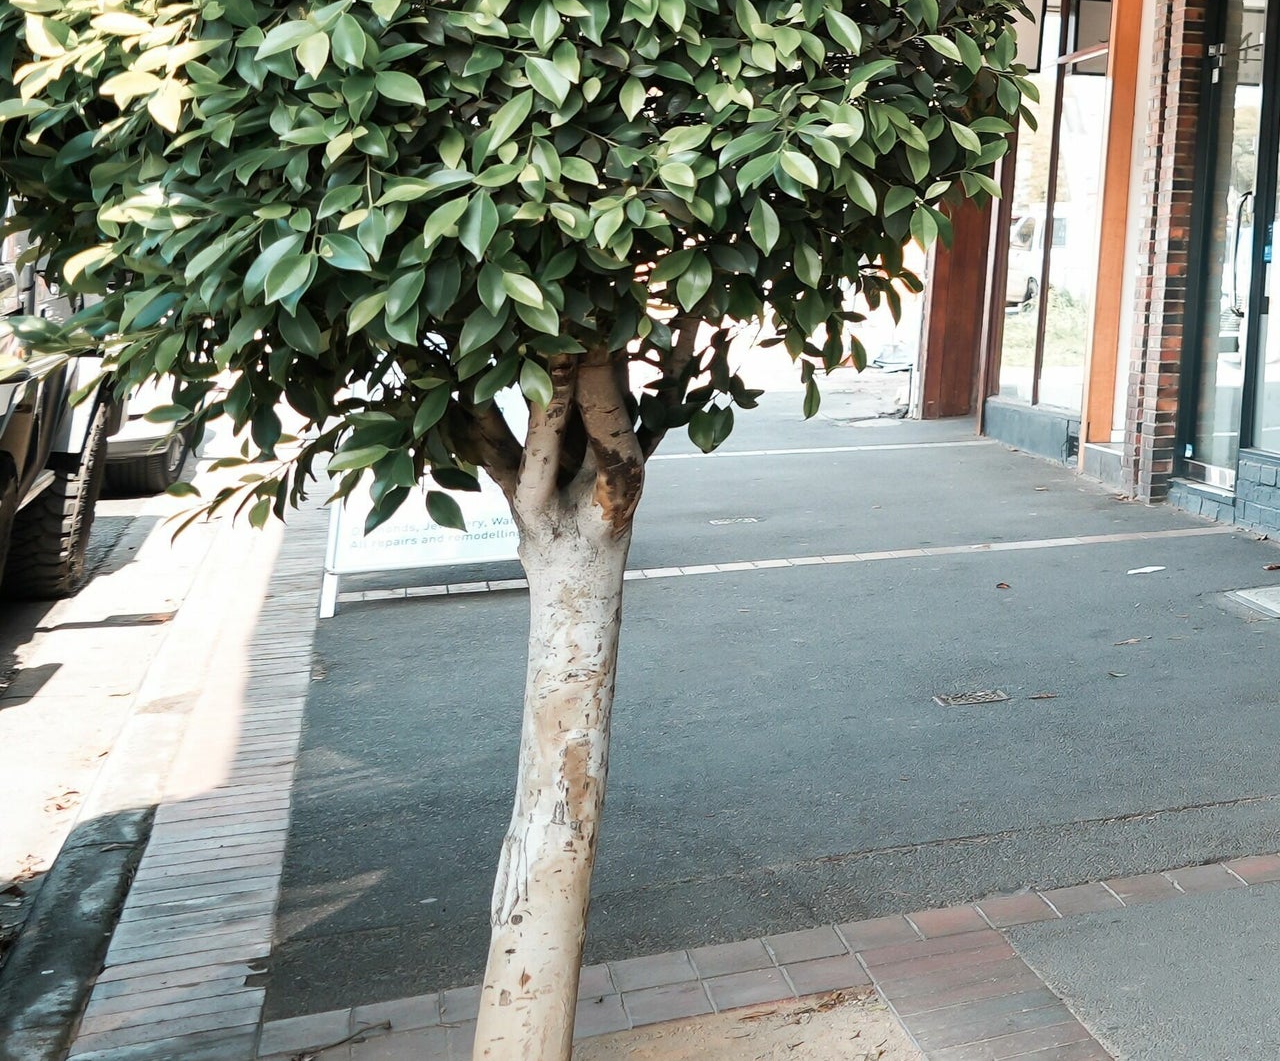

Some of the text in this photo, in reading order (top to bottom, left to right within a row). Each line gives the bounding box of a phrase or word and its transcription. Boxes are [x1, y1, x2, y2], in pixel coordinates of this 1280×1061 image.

[351, 539, 367, 549] All
[371, 535, 417, 549] repairs
[421, 533, 445, 545] and
